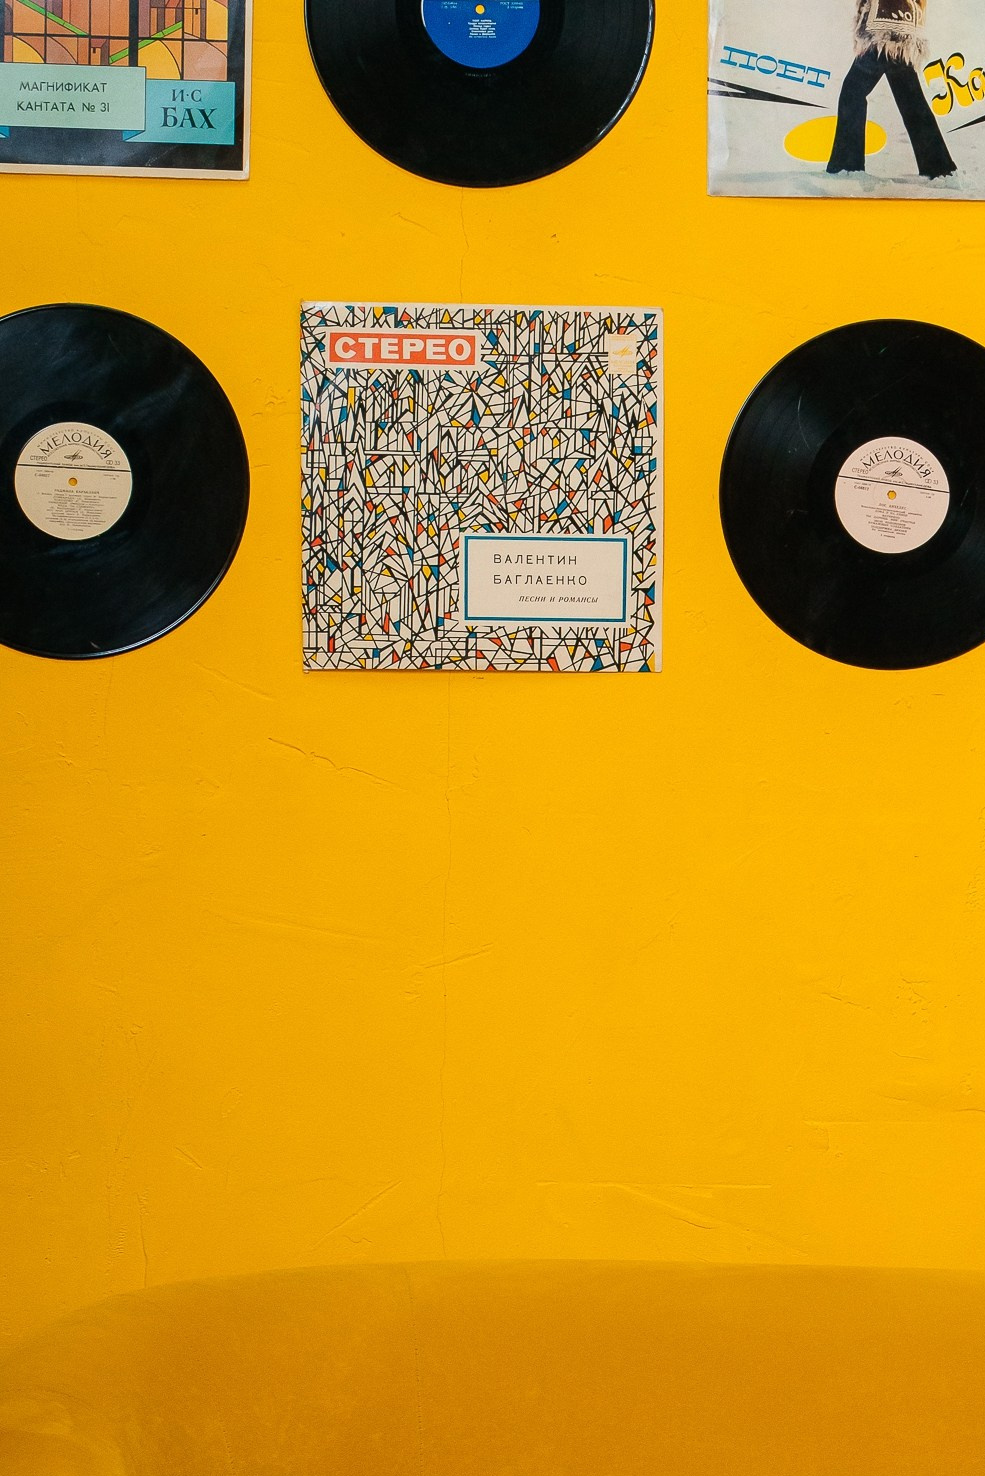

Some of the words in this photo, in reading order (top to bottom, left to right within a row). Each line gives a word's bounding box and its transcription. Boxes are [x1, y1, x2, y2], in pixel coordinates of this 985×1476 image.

[720, 45, 831, 89] ПОЕТ
[19, 81, 108, 93] МАГНИФИКАТ
[16, 101, 76, 113] КАНТАТА
[82, 102, 96, 113] №
[100, 102, 110, 113] 31
[160, 106, 218, 130] БАХ
[334, 336, 472, 361] СТЕРЕО
[39, 432, 112, 459] МЕЛОДИЯ
[862, 450, 931, 478] МЕЛОДИЯ
[493, 554, 577, 565] ВАЛЕНТИН
[493, 574, 587, 585] БАГЛАЕНКО
